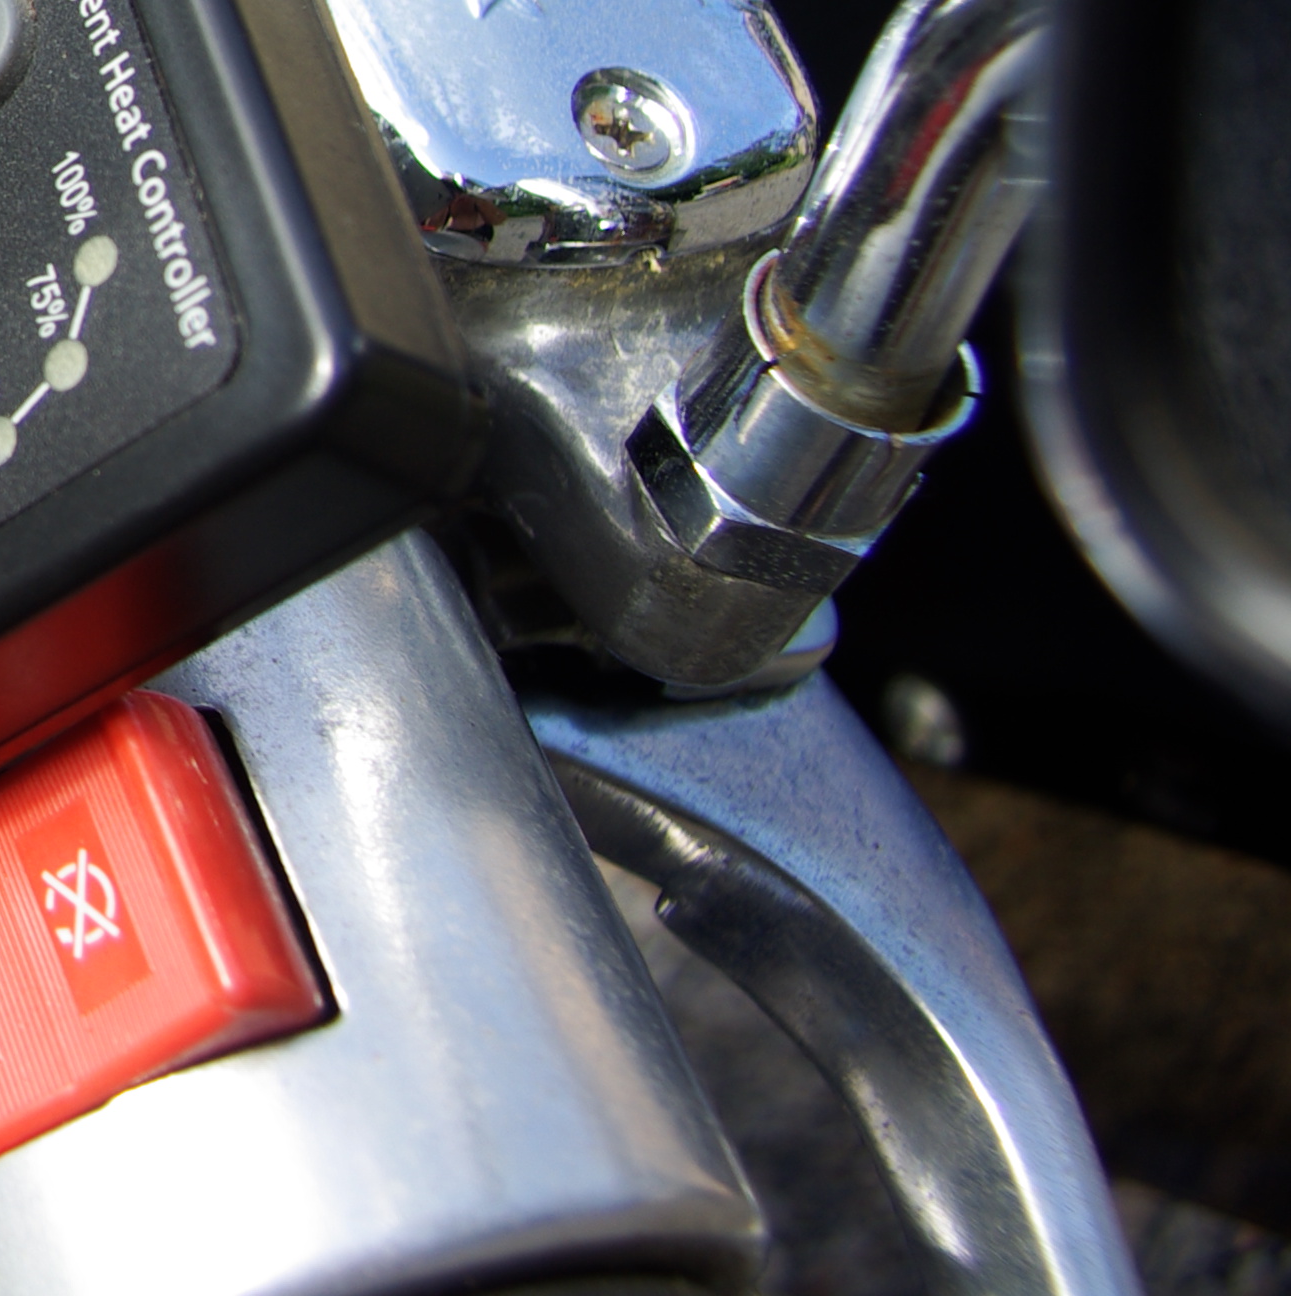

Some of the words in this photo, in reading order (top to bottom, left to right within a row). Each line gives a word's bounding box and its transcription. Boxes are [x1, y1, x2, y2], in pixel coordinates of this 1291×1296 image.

[51, 151, 98, 236] 100%
[99, 51, 152, 151] Heat
[131, 150, 216, 348] Controller
[26, 263, 69, 339] 75%
